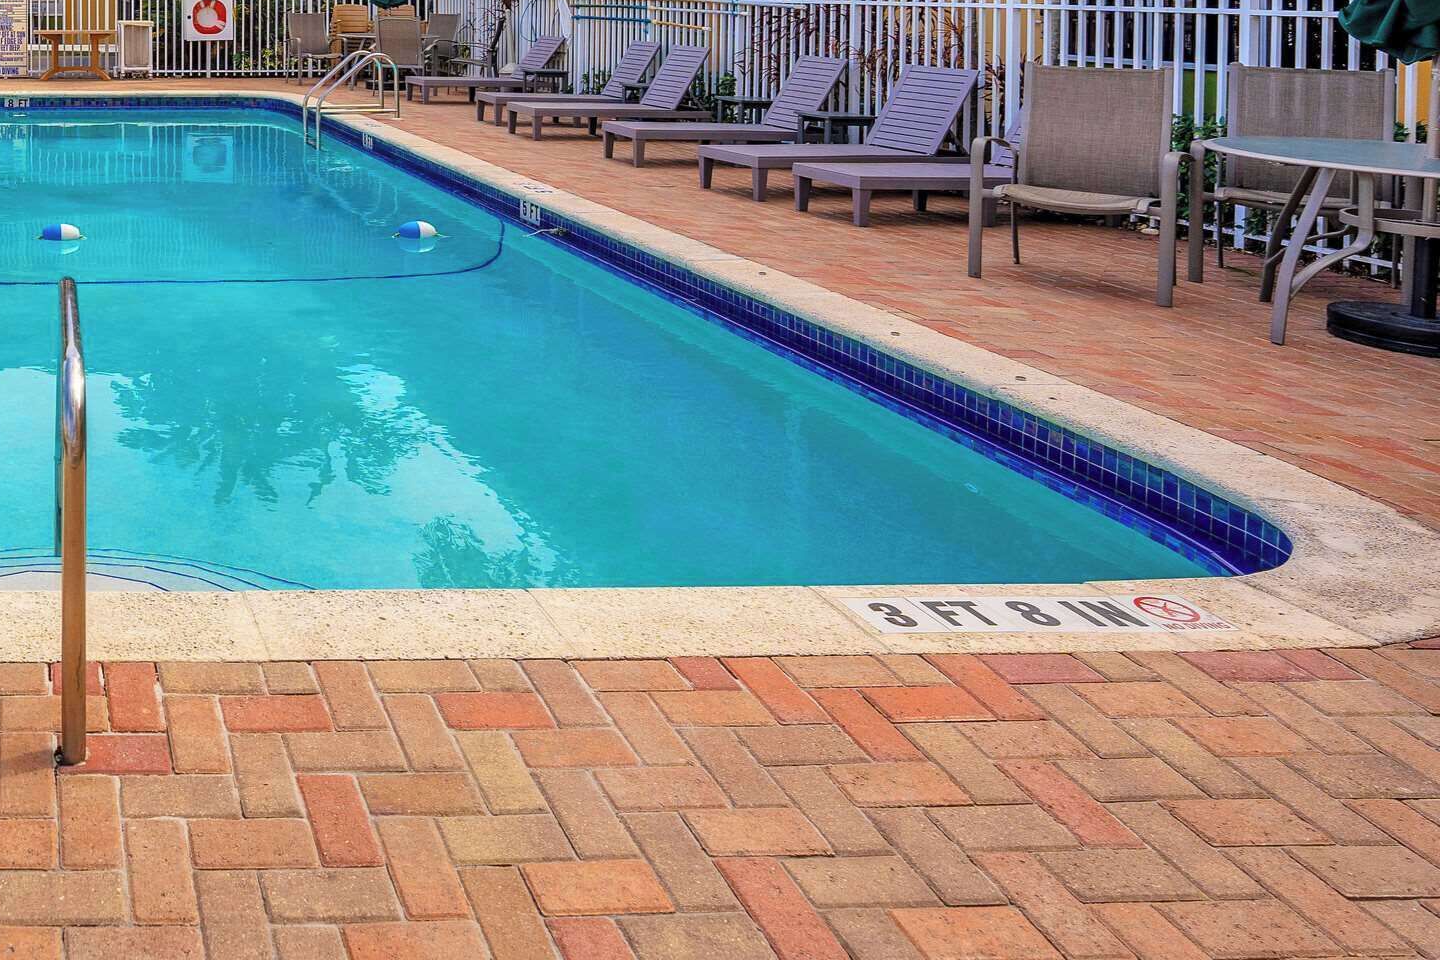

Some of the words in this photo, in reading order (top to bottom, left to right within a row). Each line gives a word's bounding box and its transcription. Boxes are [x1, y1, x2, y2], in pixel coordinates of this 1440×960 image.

[8, 99, 14, 108] 8
[18, 99, 28, 108] FT
[868, 602, 918, 628] 3
[920, 600, 998, 627] FT
[1005, 600, 1062, 627] 8
[1057, 600, 1150, 628] IN
